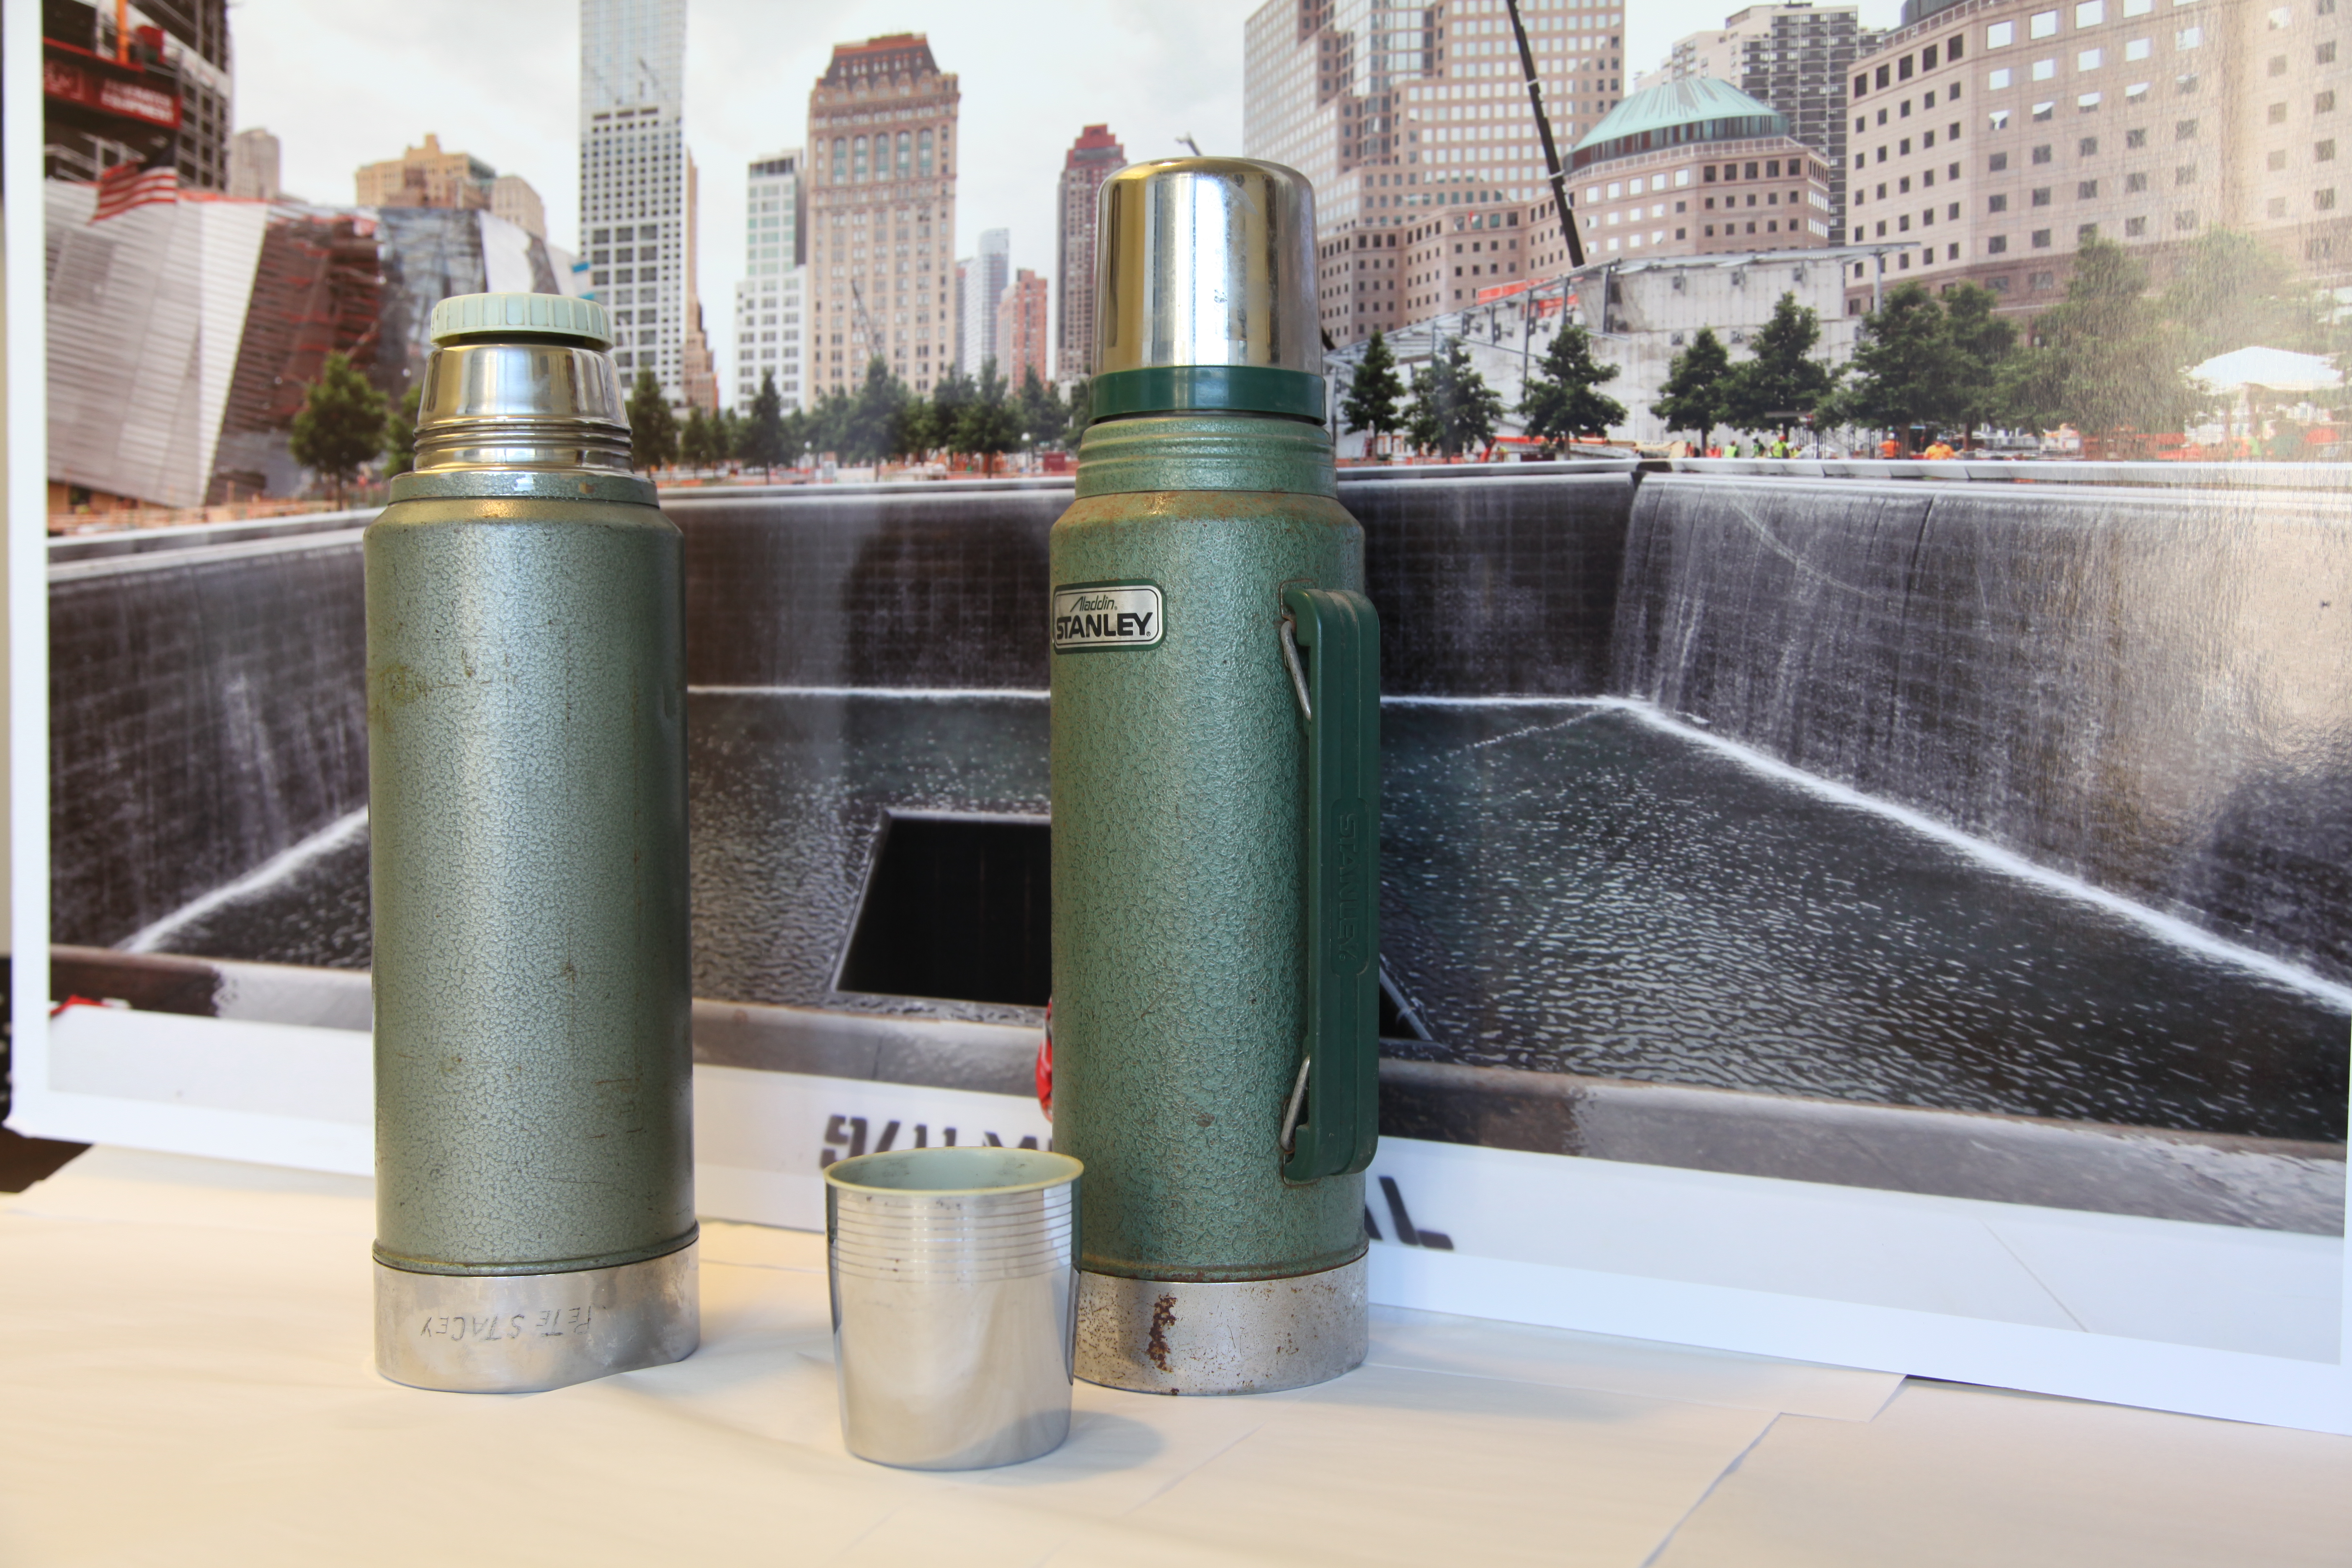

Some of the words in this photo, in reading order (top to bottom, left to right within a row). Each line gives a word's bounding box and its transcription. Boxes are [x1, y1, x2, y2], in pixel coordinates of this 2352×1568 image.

[1070, 595, 1114, 612] Aladdin
[1057, 612, 1153, 640] STANLEY
[1339, 813, 1357, 961] STANLEY
[421, 1314, 524, 1342] STACEY
[536, 1306, 591, 1337] PETE
